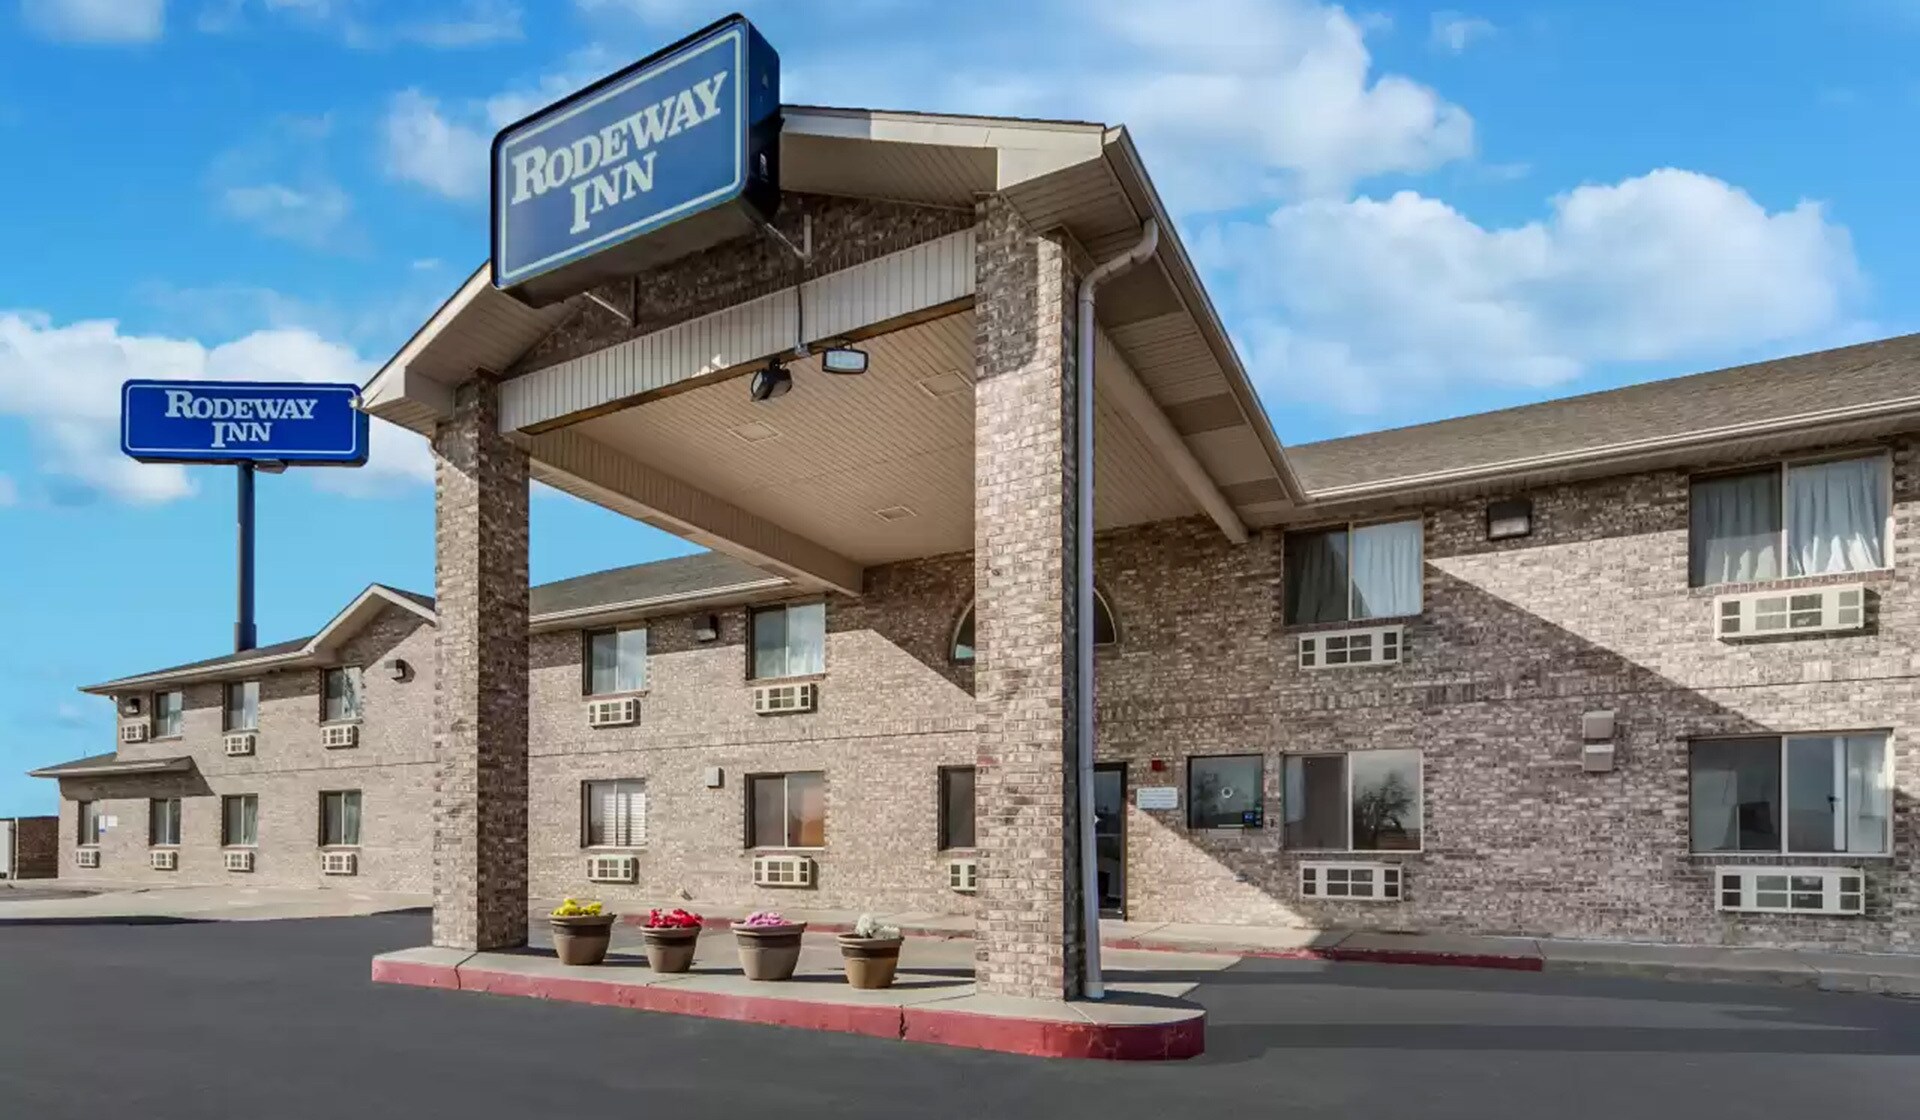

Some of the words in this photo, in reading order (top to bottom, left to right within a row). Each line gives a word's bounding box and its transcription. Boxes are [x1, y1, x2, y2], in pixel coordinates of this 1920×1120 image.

[511, 71, 727, 204] RODEWAY
[570, 151, 656, 234] INN
[164, 390, 318, 419] RODEWAY
[211, 421, 272, 447] INN
